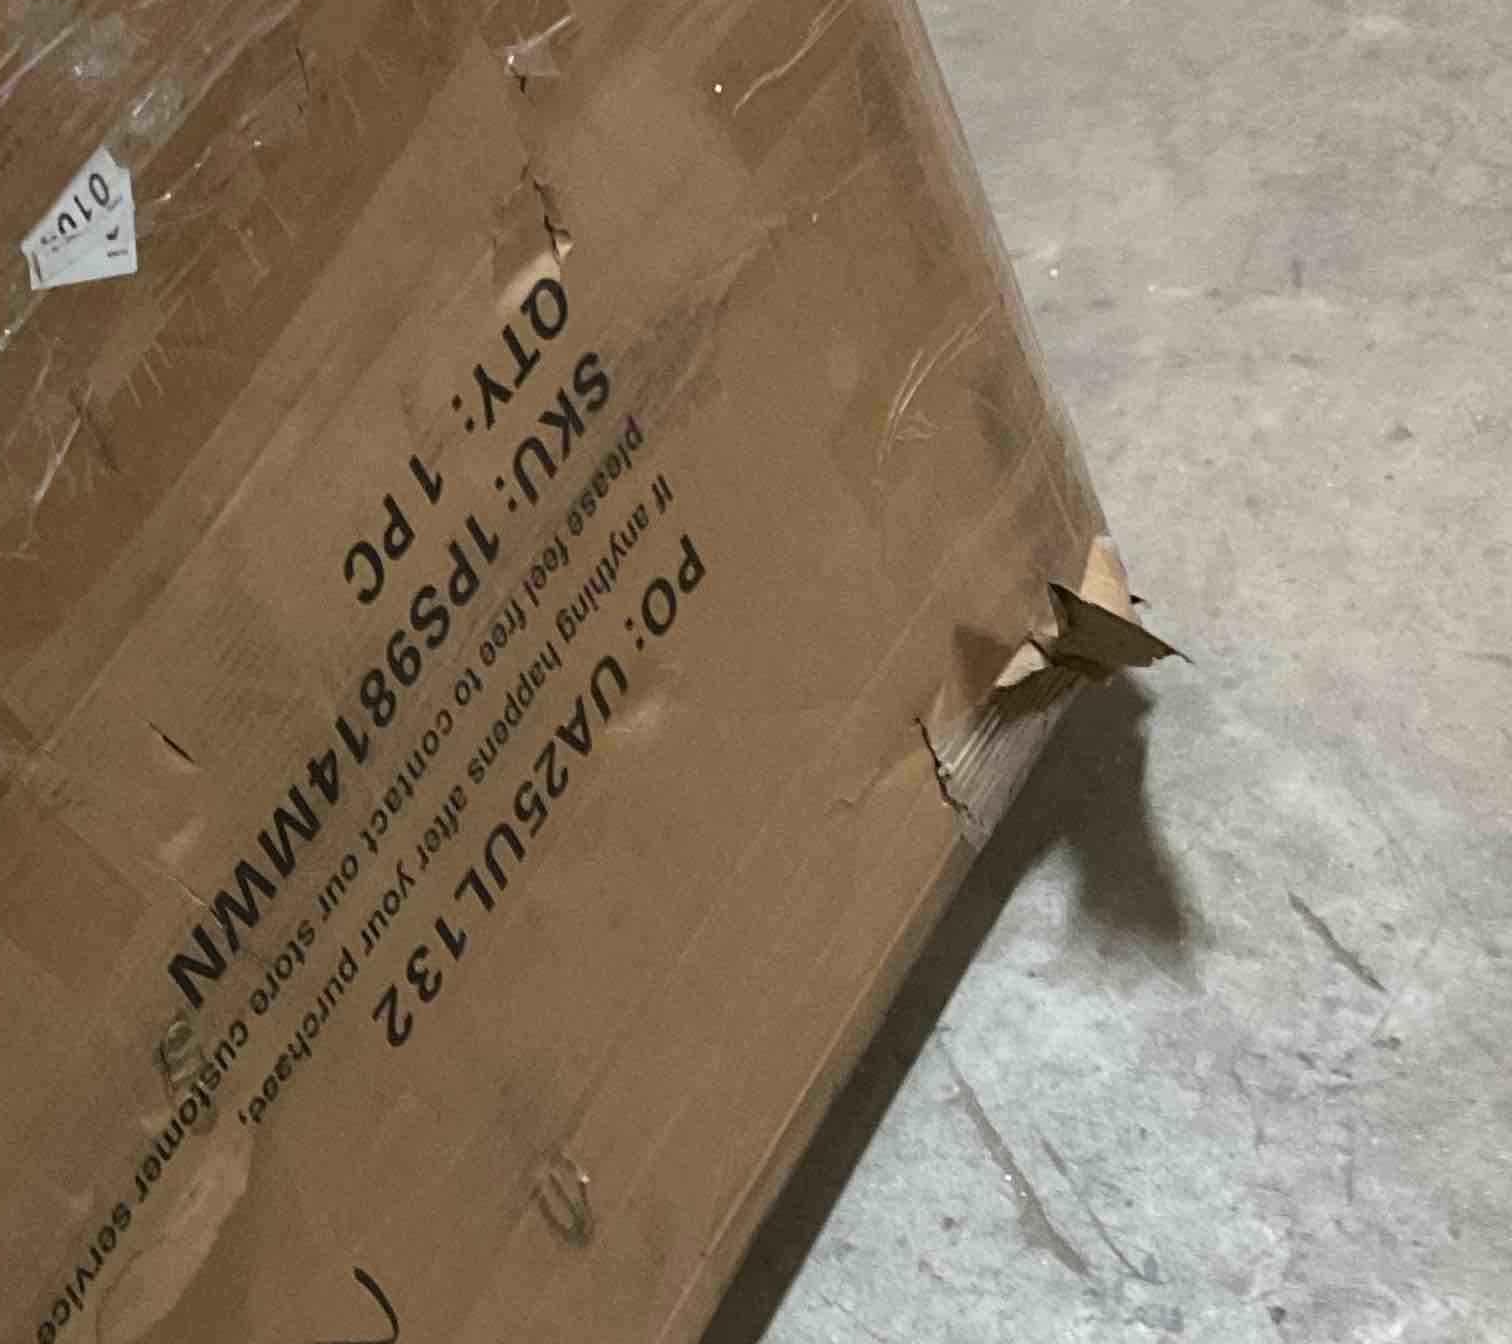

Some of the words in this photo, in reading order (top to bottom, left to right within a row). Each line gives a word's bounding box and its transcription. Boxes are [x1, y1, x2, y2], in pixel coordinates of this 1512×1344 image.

[451, 277, 569, 433] QTY:
[409, 454, 442, 506] 1
[495, 351, 610, 513] SKU:
[567, 415, 645, 537] please
[344, 493, 416, 605] PC
[651, 474, 675, 516] If
[522, 535, 570, 607] feel
[556, 503, 650, 643] anything
[624, 533, 707, 651] PO:
[454, 667, 484, 707] to
[478, 599, 527, 667] free
[167, 514, 500, 1010] 1PS9814MWN
[467, 640, 563, 785] happens
[359, 708, 455, 855] contact
[416, 784, 469, 872] after
[317, 854, 359, 923] our
[359, 859, 416, 957] your
[250, 919, 316, 1016] store
[134, 1019, 249, 1203] customer
